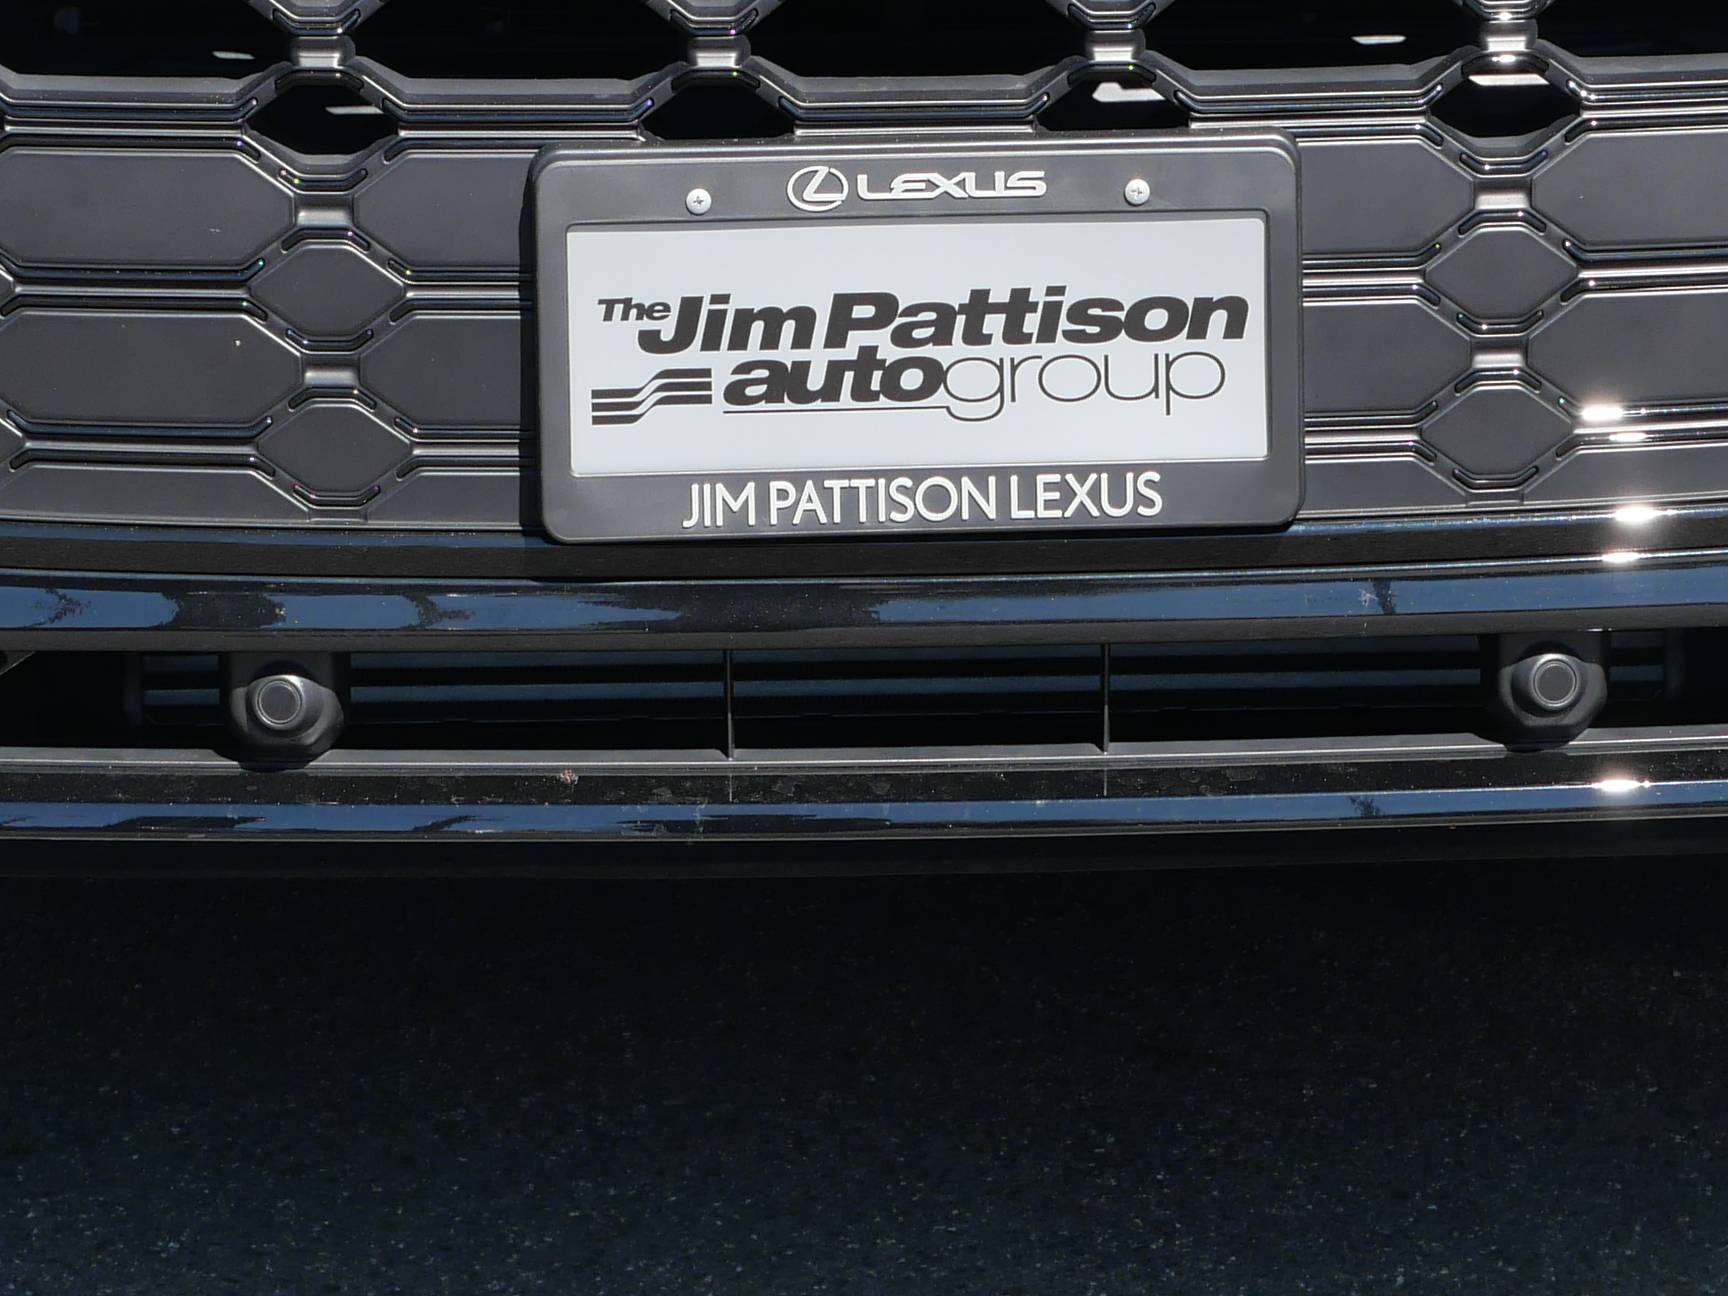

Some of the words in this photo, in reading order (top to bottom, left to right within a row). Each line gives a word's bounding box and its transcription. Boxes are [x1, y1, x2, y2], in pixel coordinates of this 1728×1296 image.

[857, 170, 1048, 201] LEXUS
[597, 297, 673, 323] The
[682, 480, 757, 530] JIM
[769, 473, 998, 526] PATTISON
[1010, 470, 1163, 521] LEXUS
